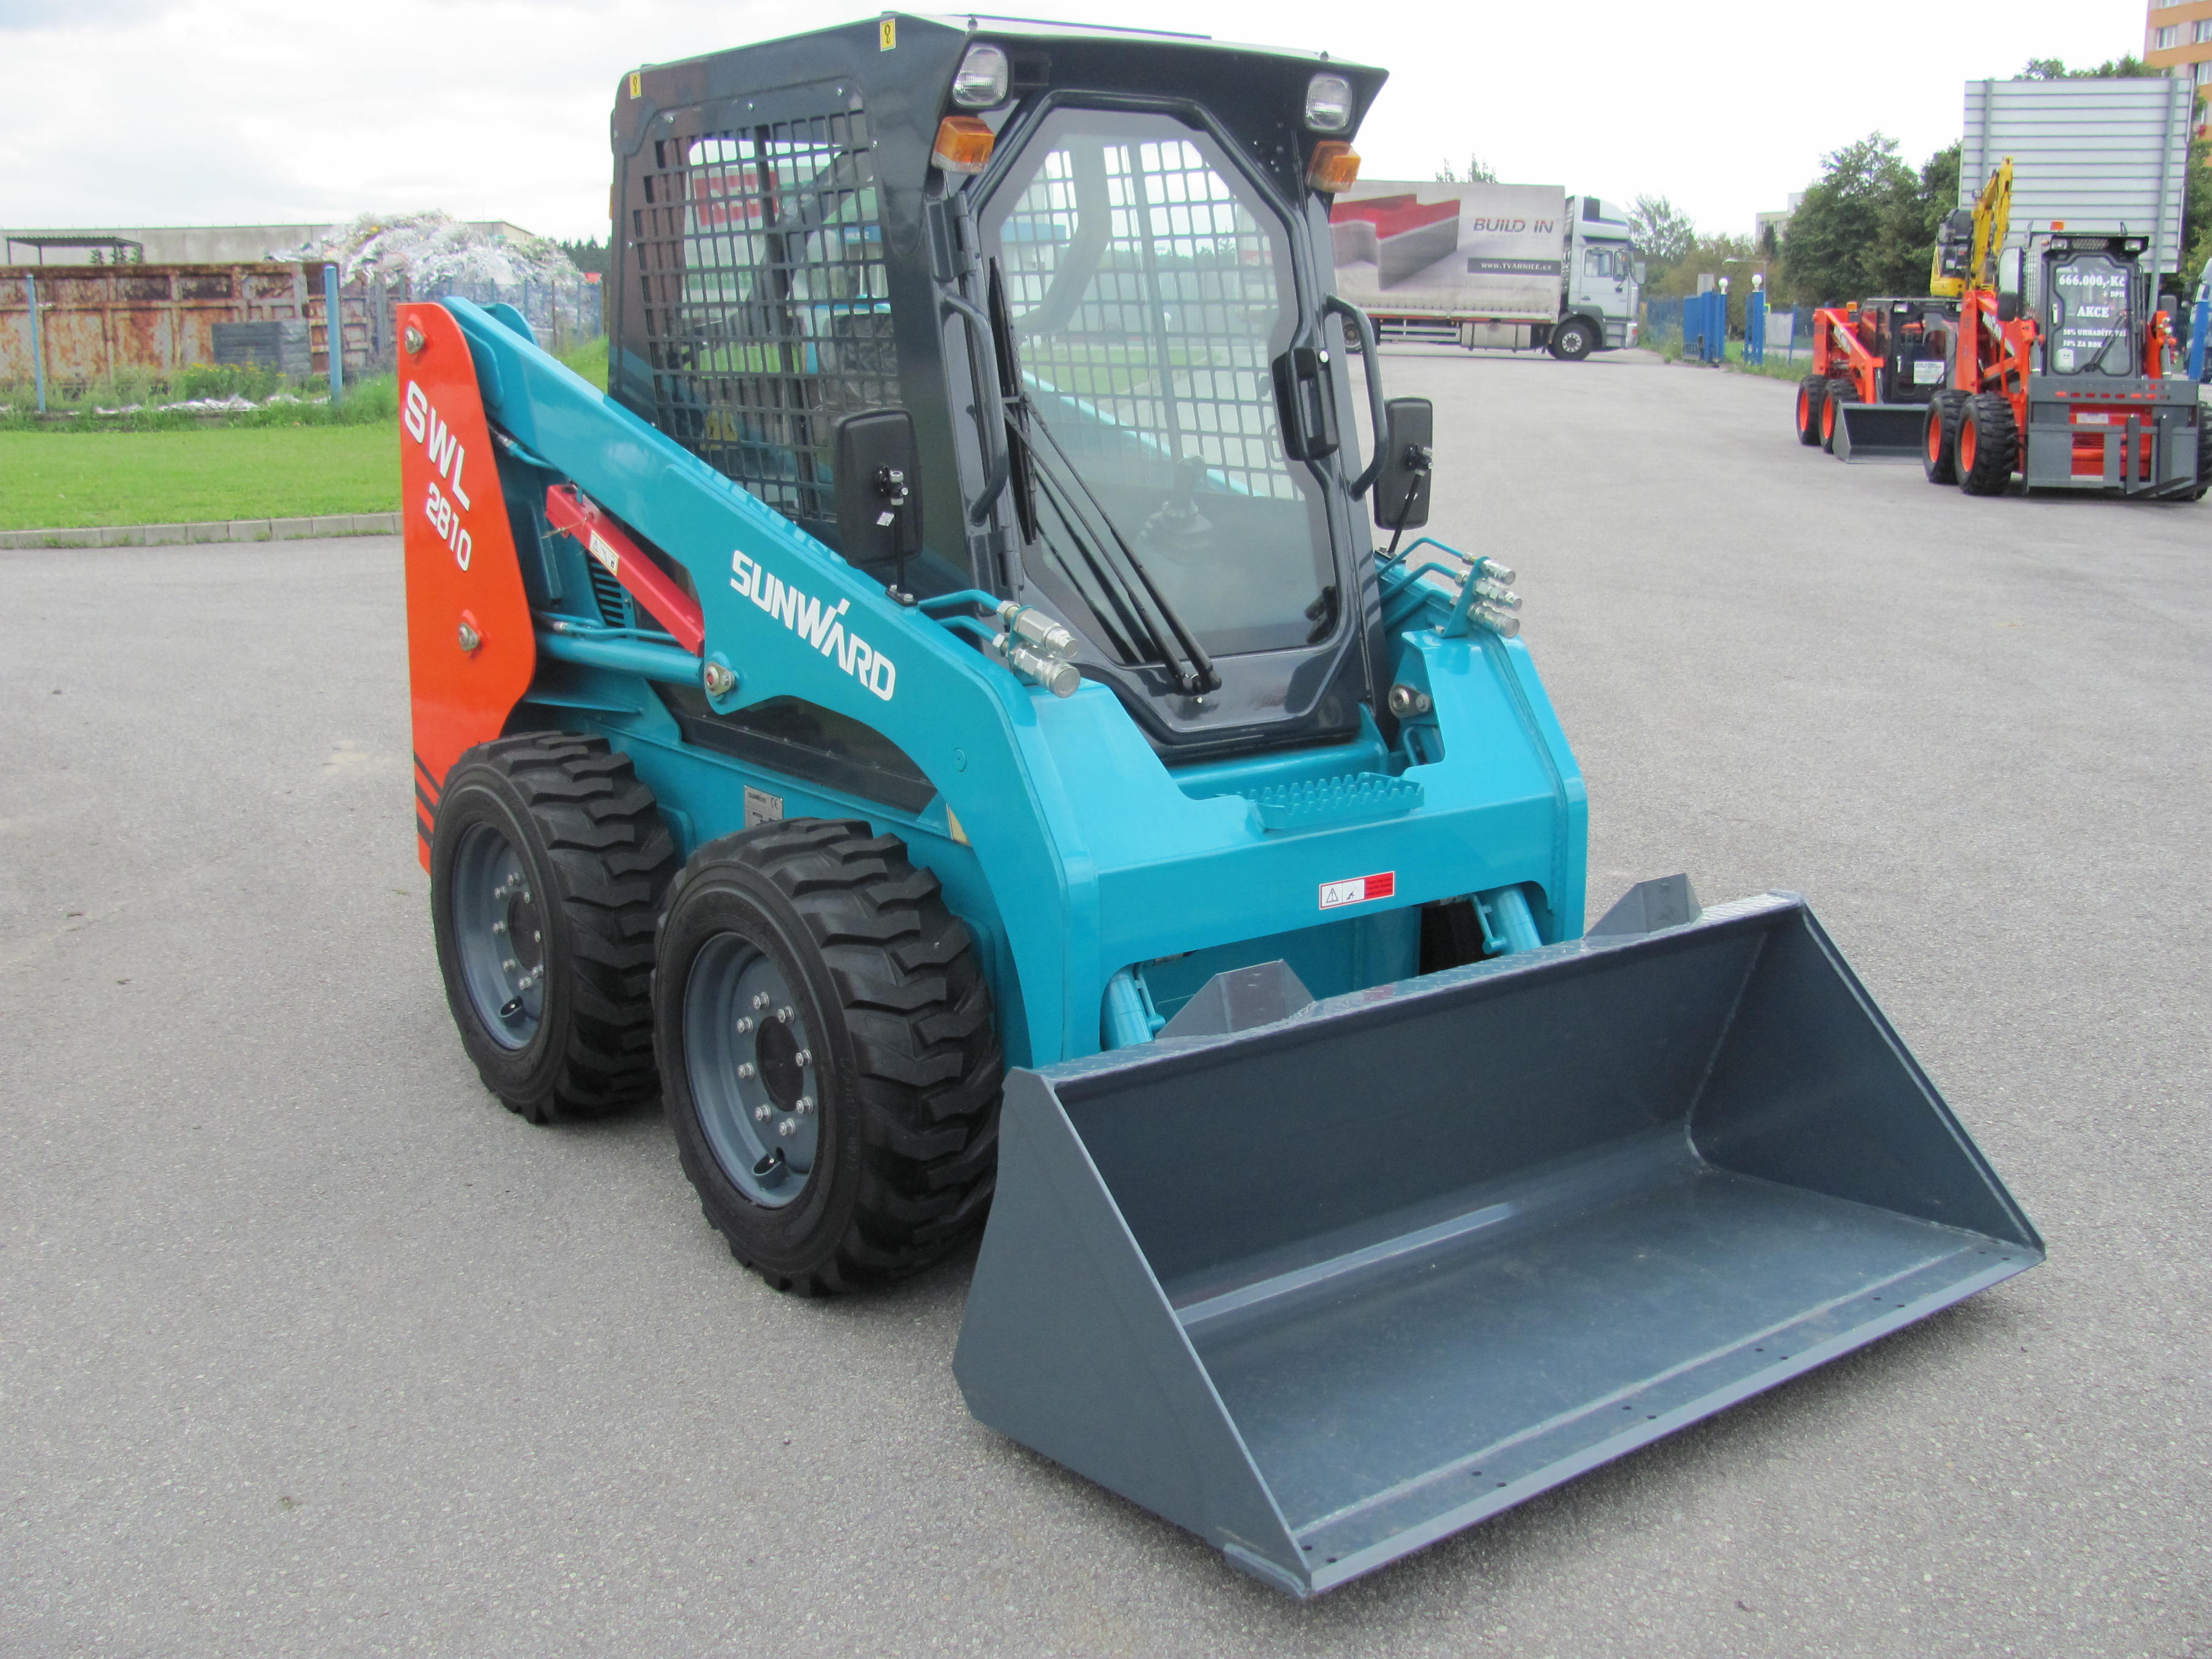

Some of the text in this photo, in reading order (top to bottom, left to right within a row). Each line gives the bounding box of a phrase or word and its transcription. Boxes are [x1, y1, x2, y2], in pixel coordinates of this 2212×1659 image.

[1473, 218, 1553, 233] BUILD IN
[2076, 306, 2109, 318] AKCE
[404, 381, 470, 511] SWL
[426, 482, 472, 572] 2810
[730, 550, 896, 702] SUNWARD
